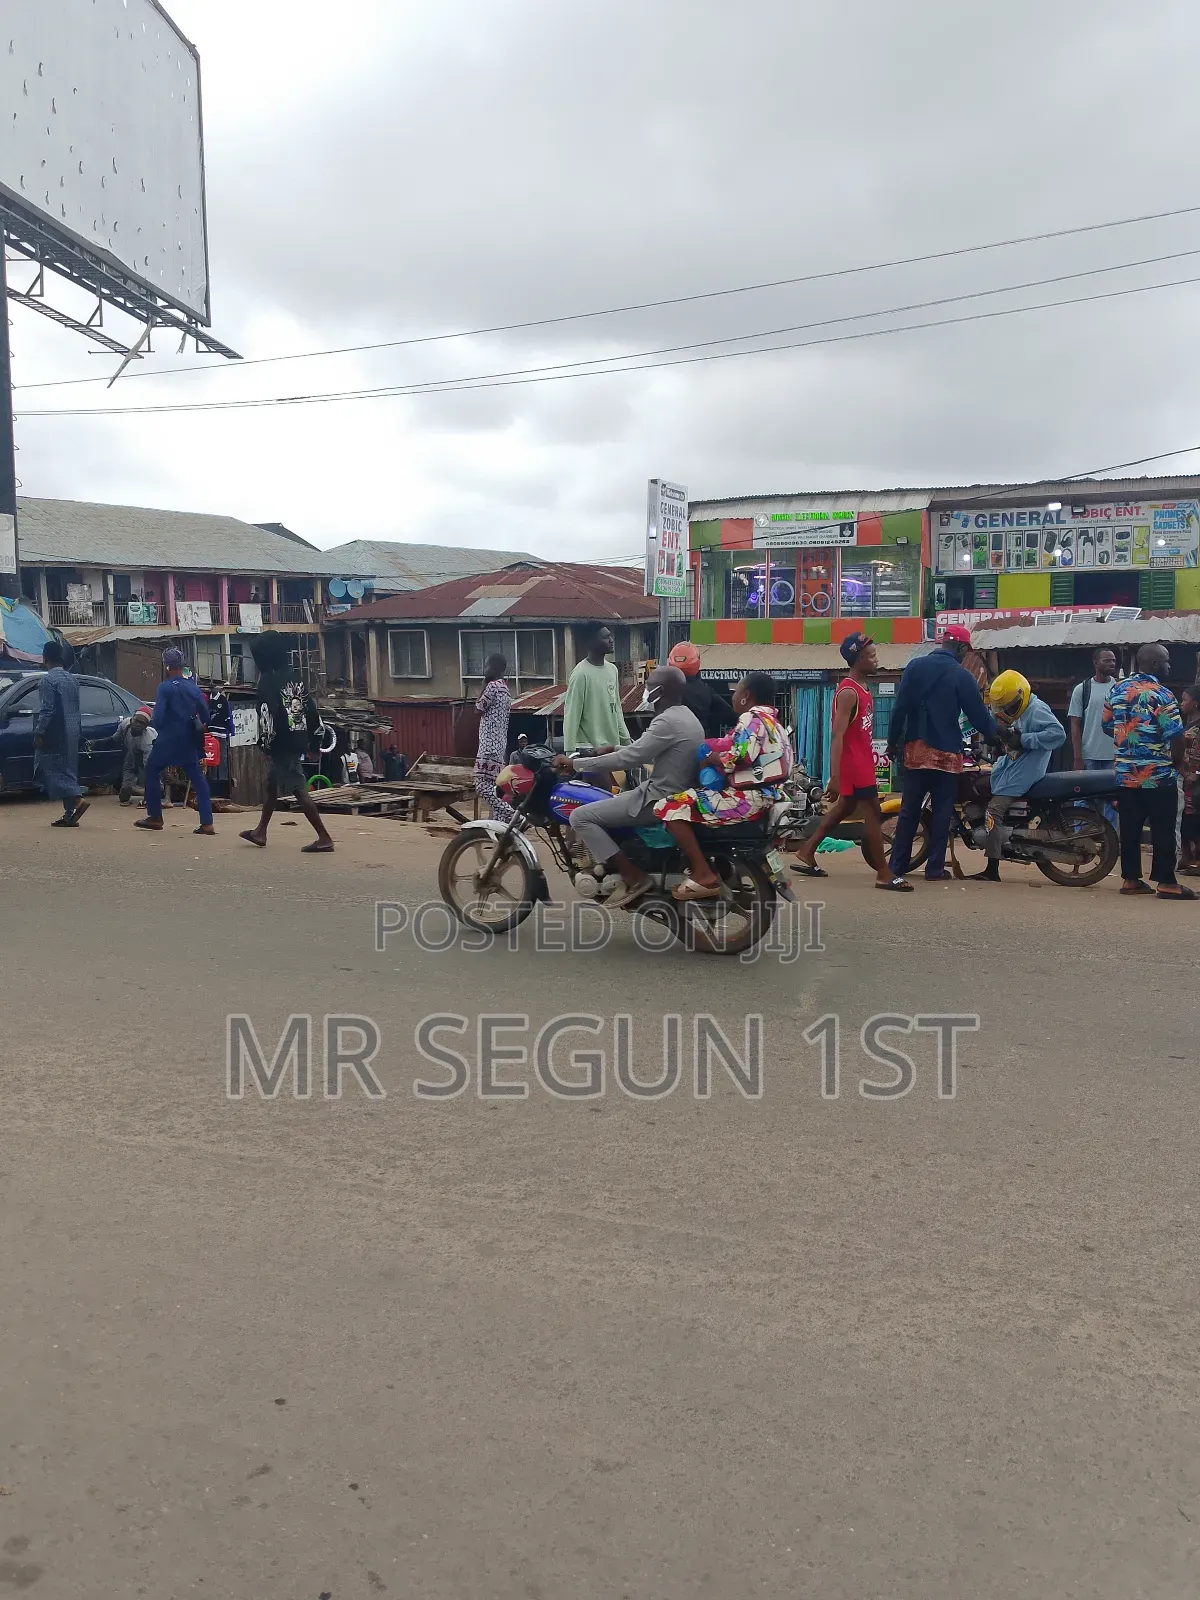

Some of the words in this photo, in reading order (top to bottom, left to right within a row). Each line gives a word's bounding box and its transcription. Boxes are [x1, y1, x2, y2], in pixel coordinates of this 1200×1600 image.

[660, 501, 686, 519] GENERAL
[974, 510, 1067, 529] GENERAL
[1115, 505, 1146, 517] ENT.
[662, 517, 683, 532] ZOBIC
[661, 530, 681, 550] ENT.
